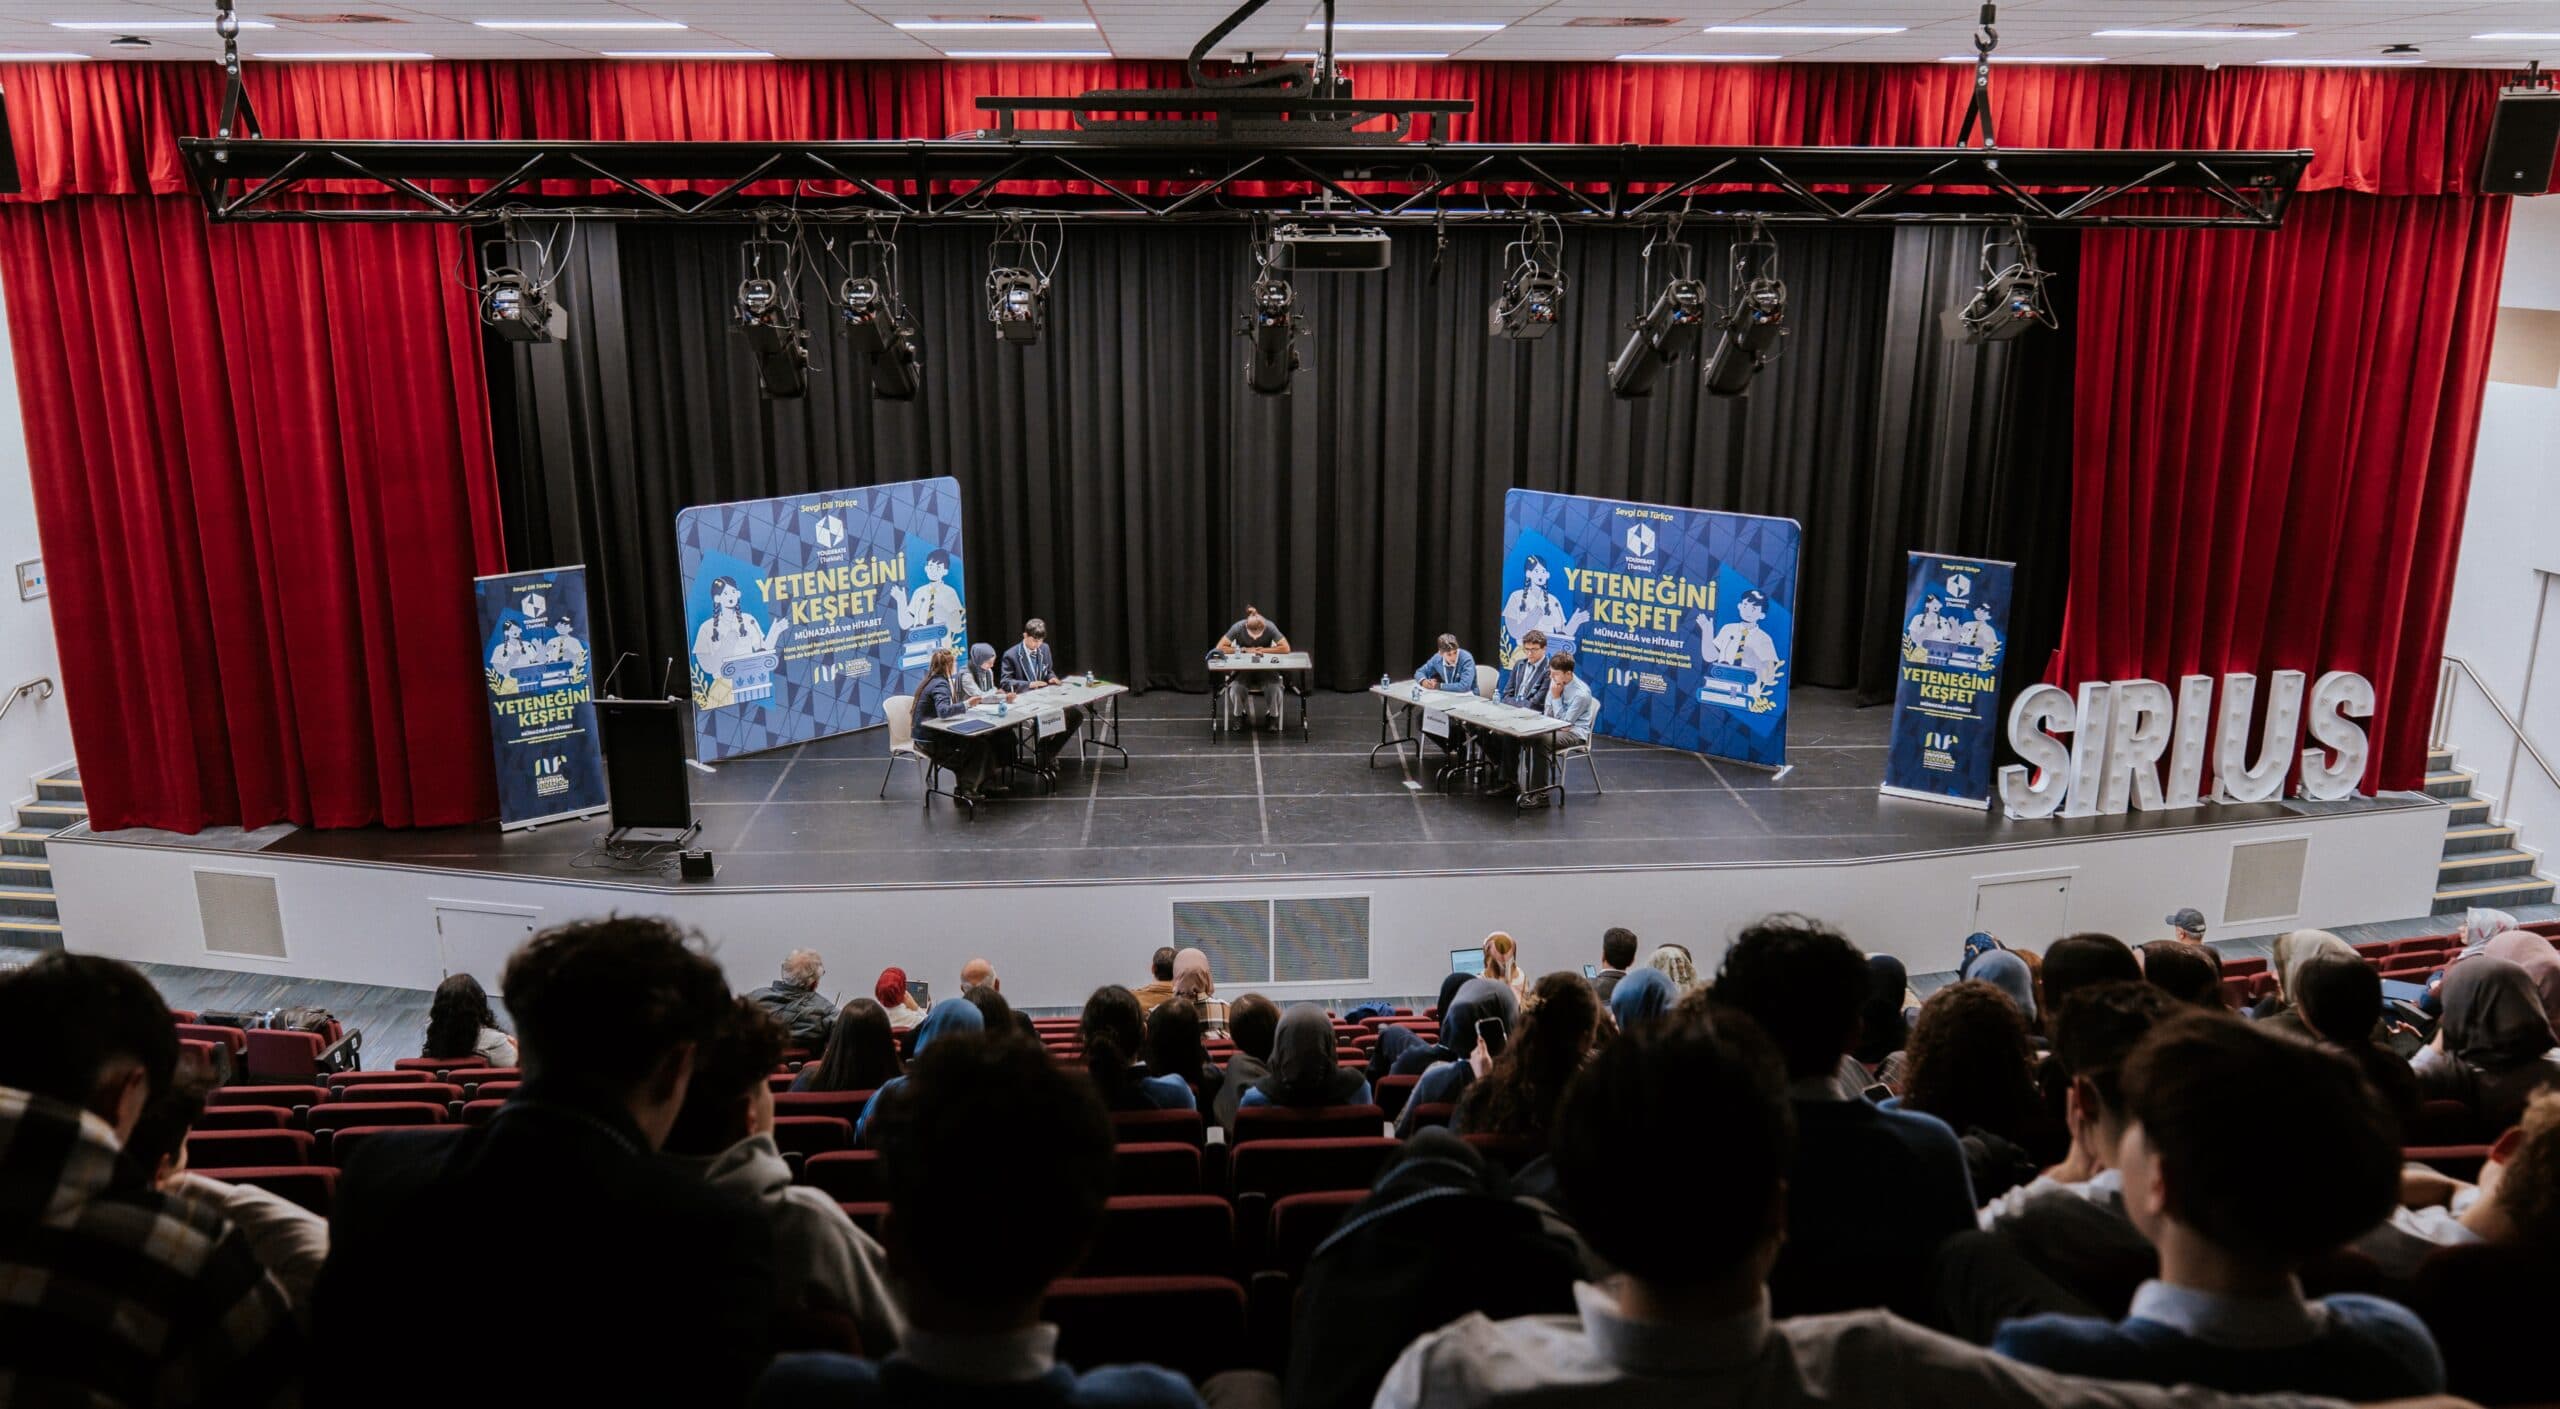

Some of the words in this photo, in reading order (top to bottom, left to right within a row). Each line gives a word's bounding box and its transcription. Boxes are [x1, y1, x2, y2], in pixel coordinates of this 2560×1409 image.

[800, 503, 820, 512] Sevgi
[834, 499, 858, 508] Türkçe
[1616, 508, 1635, 518] Sevgi
[1650, 512, 1674, 522] Türkçe
[756, 551, 905, 603] YETENEĞİNİ
[1564, 567, 1716, 611] YETENEĞİNİ
[791, 588, 877, 627] KEŞFET
[1594, 598, 1682, 633] KEŞFET
[794, 623, 841, 640] MÜNAZARA
[852, 618, 882, 630] HİTABET
[1594, 628, 1640, 642] MÜNAZARA
[1641, 636, 1651, 644] ve
[1652, 636, 1684, 648] HİTABET
[1902, 666, 1996, 692] YETENEĞİNİ
[494, 685, 590, 715] YETENEĞİNİ
[1920, 684, 1976, 704] KEŞFET
[518, 706, 574, 727] KEŞFET
[1998, 670, 2375, 819] SIRIUS
